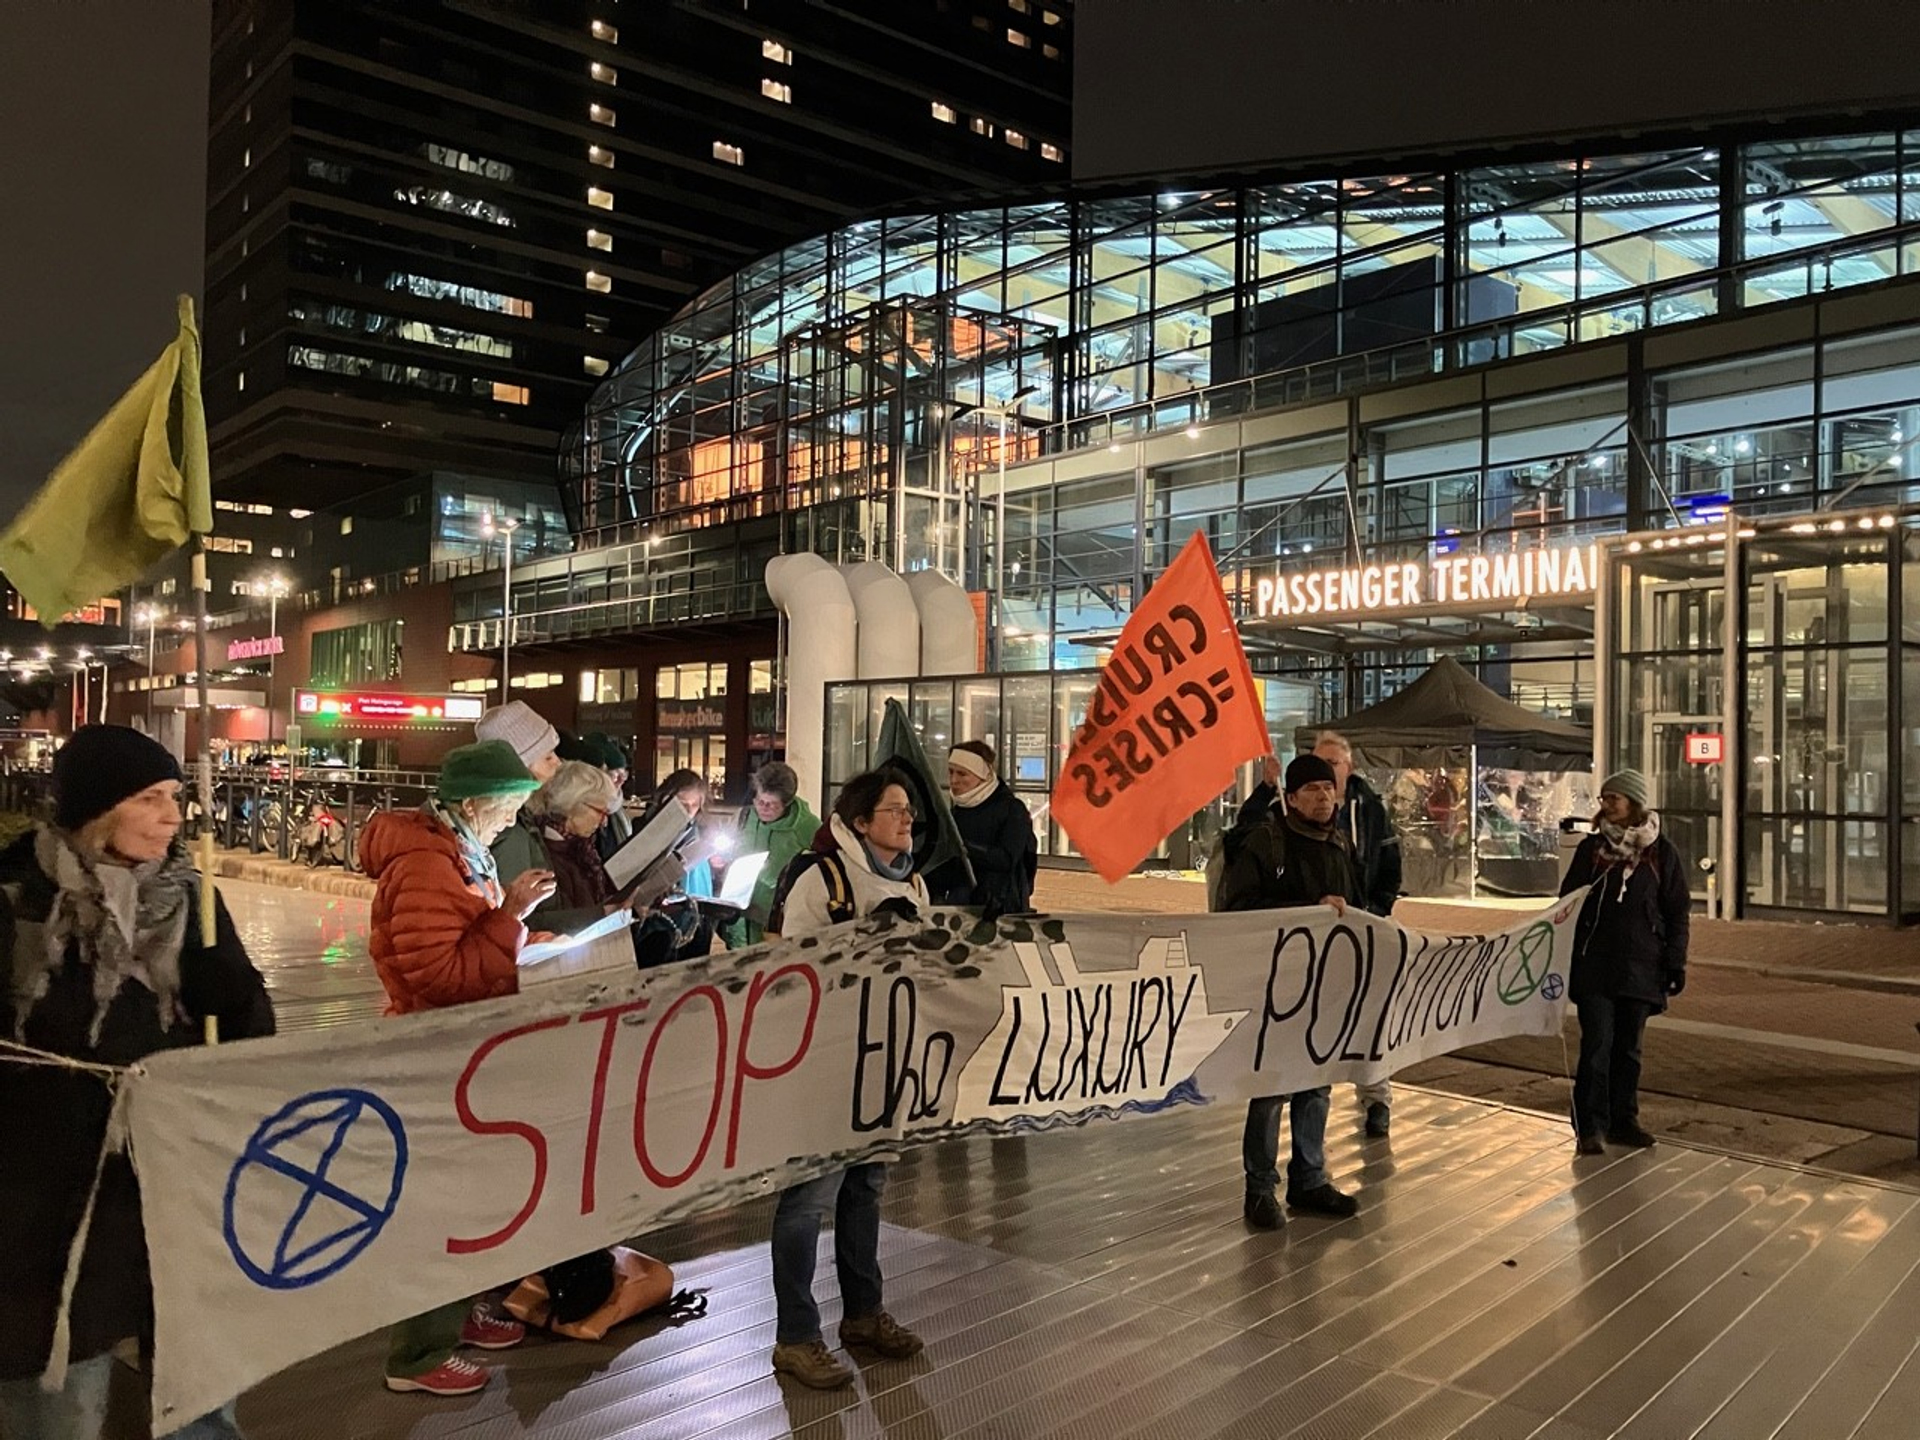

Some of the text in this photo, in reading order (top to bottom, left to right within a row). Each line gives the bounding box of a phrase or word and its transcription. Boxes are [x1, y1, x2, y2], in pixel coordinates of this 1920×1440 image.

[1257, 562, 1421, 617] PASSENGER
[1701, 743, 1709, 754] B
[446, 924, 1510, 1254] STOP the LUXURY POLLUTION
